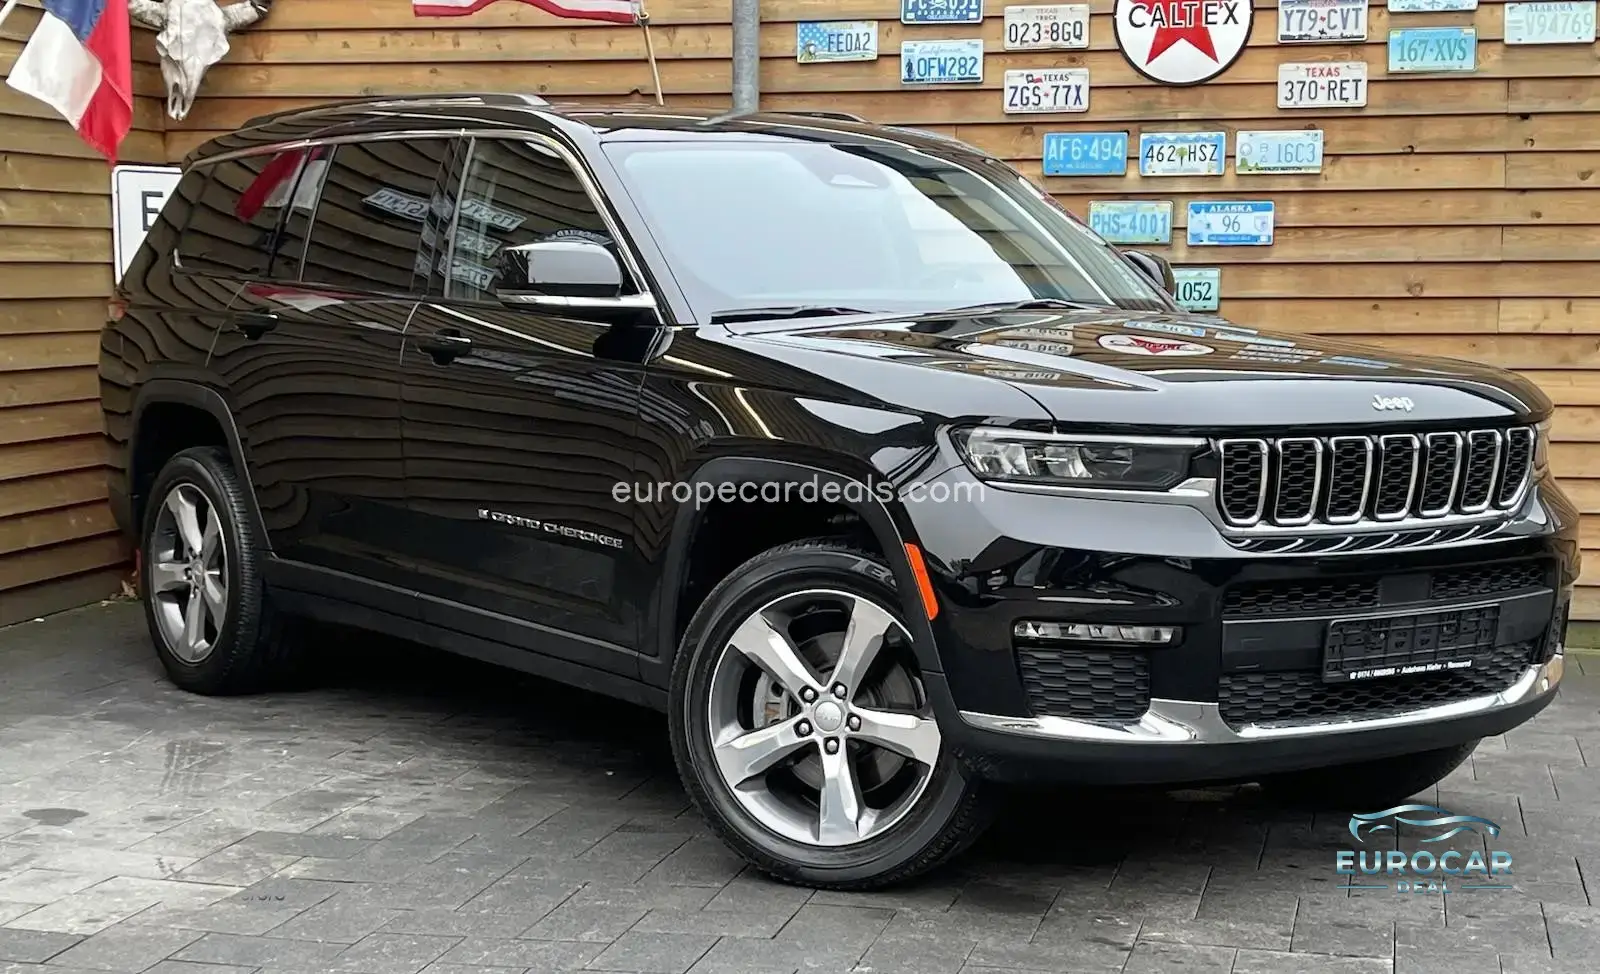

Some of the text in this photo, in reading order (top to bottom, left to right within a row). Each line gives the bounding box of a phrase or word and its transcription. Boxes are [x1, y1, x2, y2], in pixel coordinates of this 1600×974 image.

[1128, 2, 1240, 29] CALTEX
[1284, 8, 1362, 32] Y79 CVT
[1043, 73, 1070, 82] TEXAS
[1305, 67, 1341, 78] TEXAS
[1008, 84, 1083, 107] ZGS 77X
[1284, 79, 1362, 102] 370 RET
[1145, 143, 1218, 163] 462 HSZ
[1209, 204, 1253, 213] ALASKA
[1222, 214, 1241, 233] 96
[1371, 394, 1415, 412] Jeep
[491, 511, 623, 549] GRAND CHEROKEE
